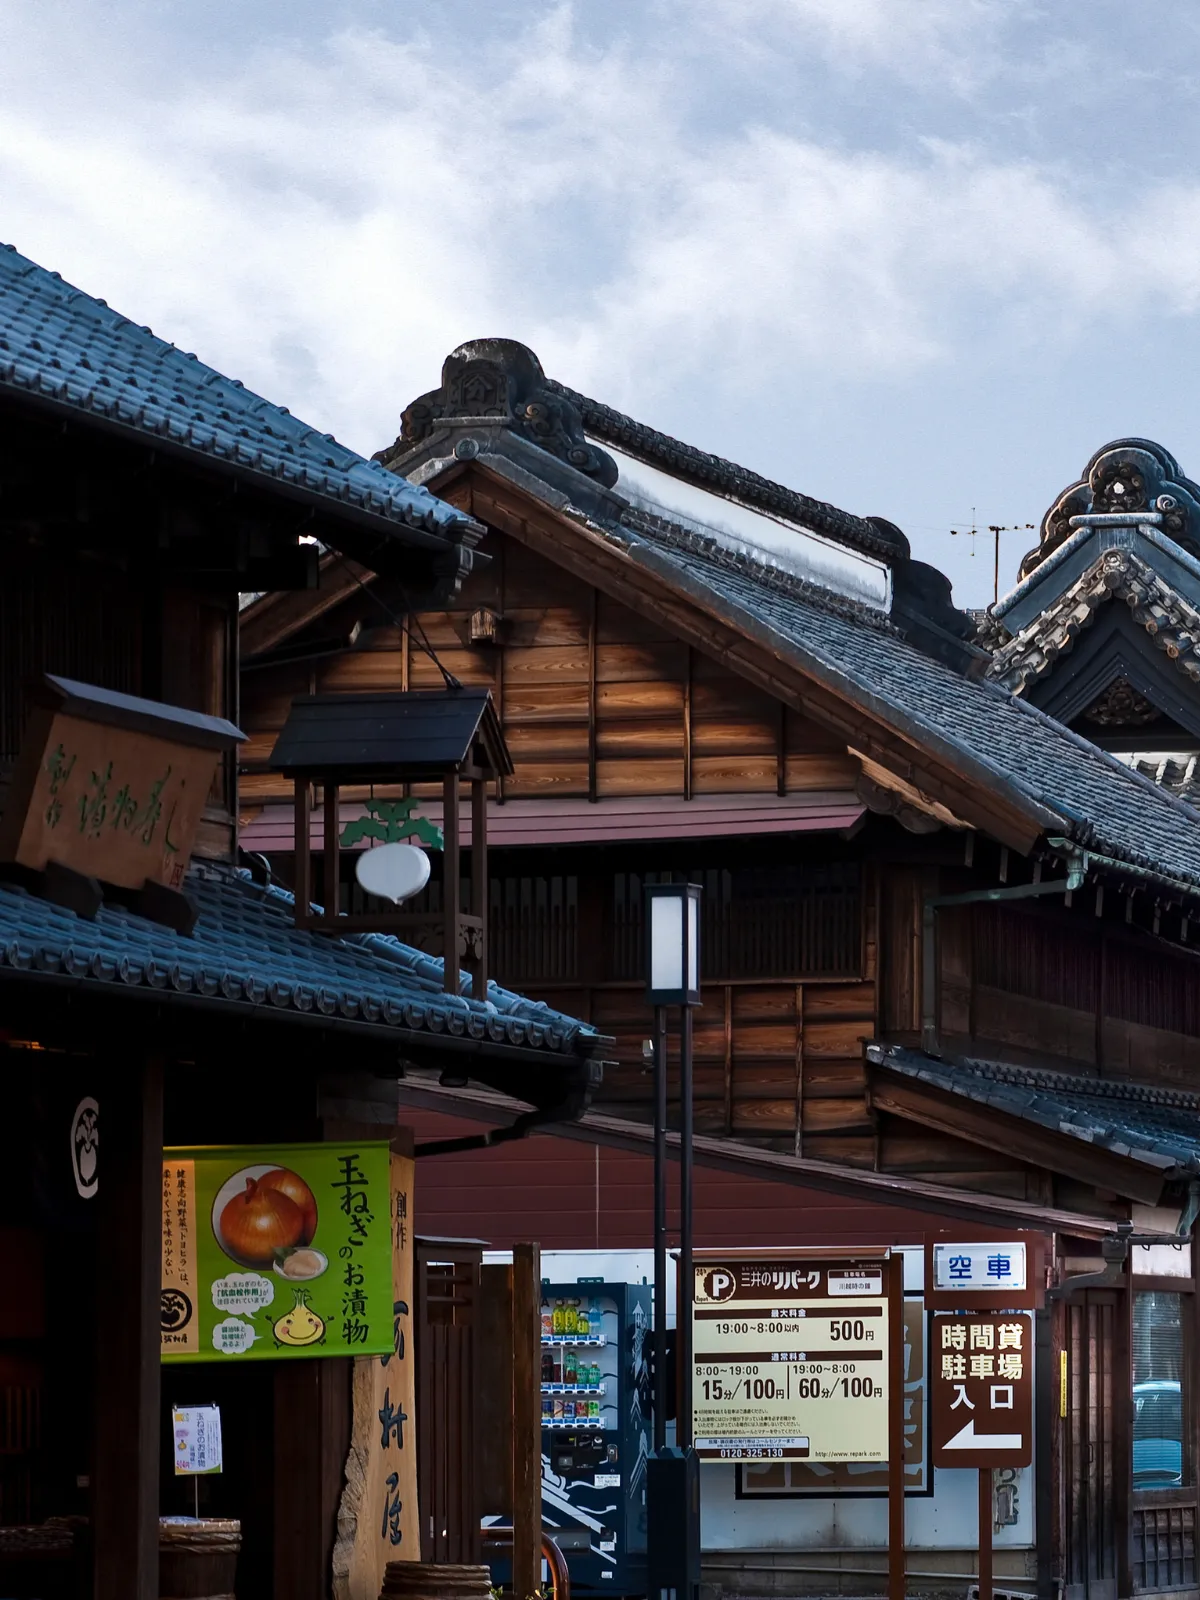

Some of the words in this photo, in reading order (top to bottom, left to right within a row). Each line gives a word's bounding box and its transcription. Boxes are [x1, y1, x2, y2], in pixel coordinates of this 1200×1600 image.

[396, 1191, 407, 1250] 創作
[331, 1154, 375, 1345] 玉ねぎのお漬物
[949, 1253, 1012, 1280] 空車
[741, 1270, 821, 1291] 三井のリパーク
[771, 1309, 807, 1318] 最大料金
[830, 1320, 875, 1341] 500円
[941, 1323, 1023, 1350] 時間貸
[771, 1352, 807, 1362] 通常料金
[941, 1353, 1023, 1380] 駐車場
[950, 1384, 1014, 1410] 入口
[720, 1448, 783, 1458] 0120-325-130
